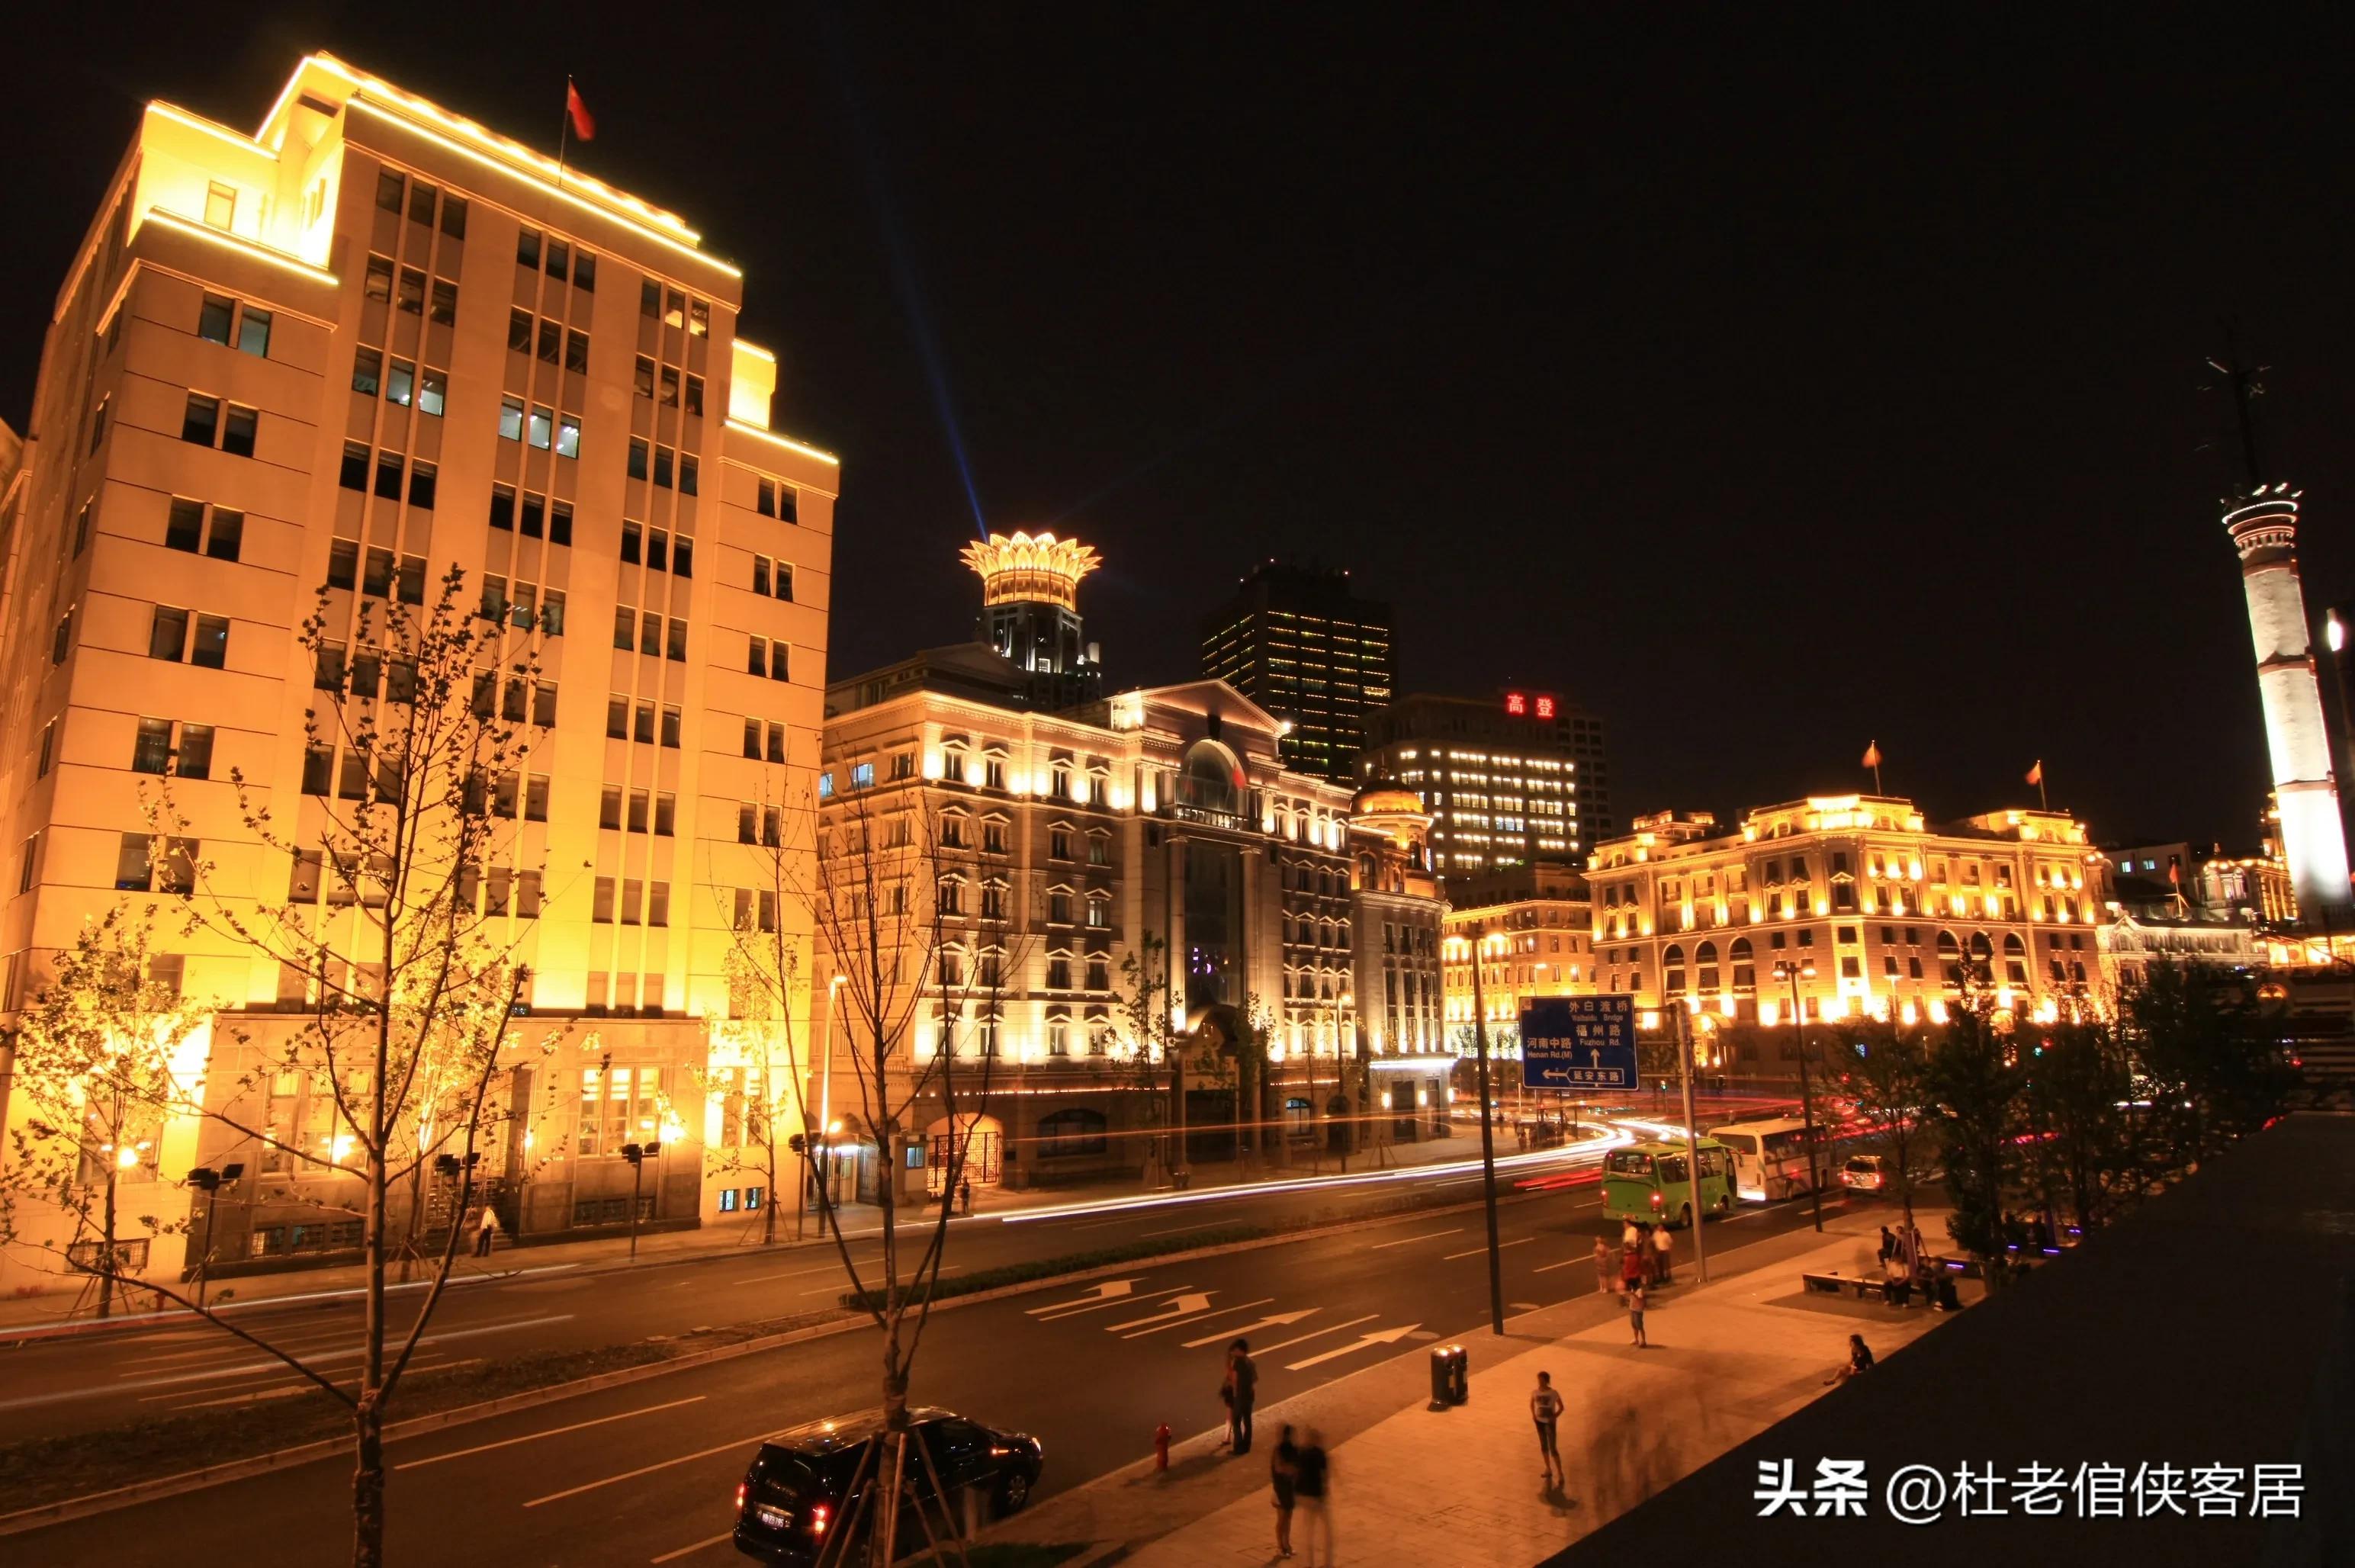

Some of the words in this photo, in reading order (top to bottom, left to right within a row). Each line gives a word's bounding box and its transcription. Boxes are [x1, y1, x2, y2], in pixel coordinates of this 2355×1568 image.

[1507, 695, 1553, 717] 高登
[1569, 1001, 1628, 1013] 外白渡桥
[1604, 1014, 1624, 1023] Bridge
[1576, 1025, 1621, 1036] 福州路
[1527, 1037, 1572, 1049] 河南中路
[1579, 1038, 1605, 1046] Fuzhou
[1609, 1038, 1621, 1046] Rd.
[1574, 1071, 1619, 1081] 延安东路
